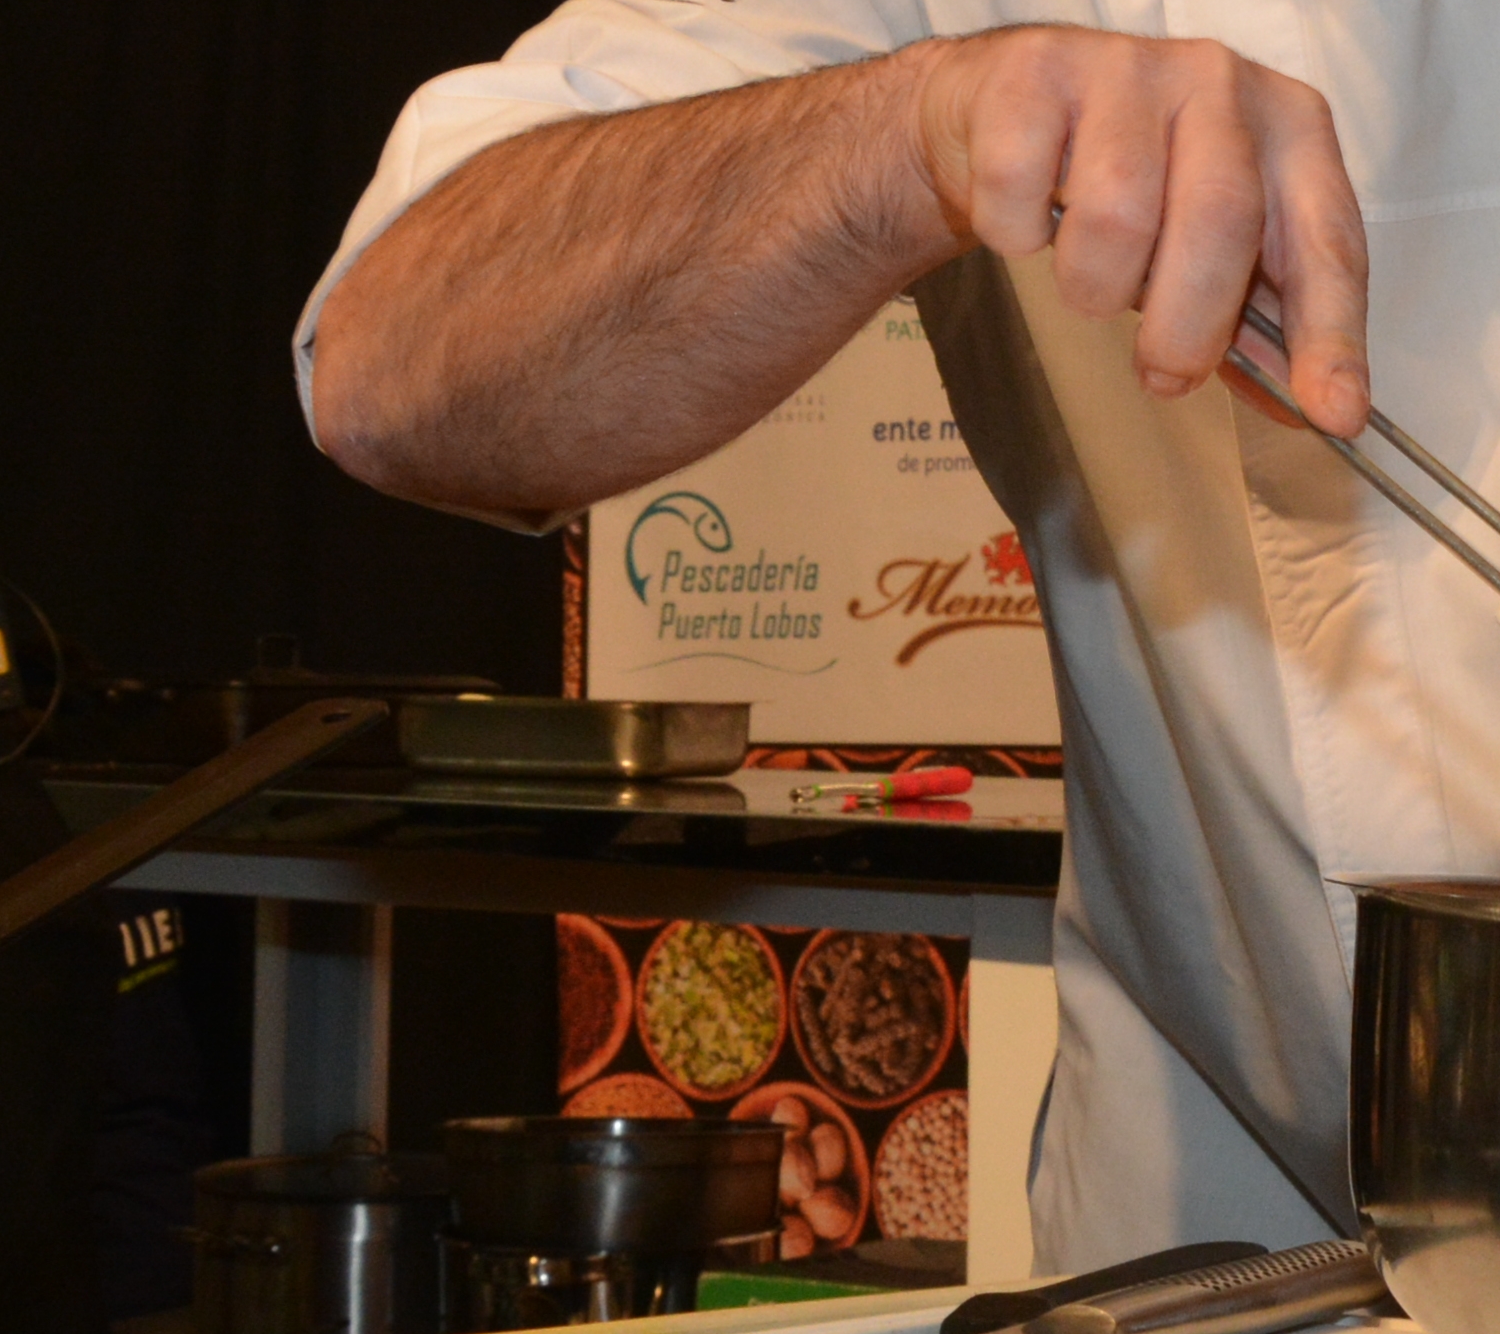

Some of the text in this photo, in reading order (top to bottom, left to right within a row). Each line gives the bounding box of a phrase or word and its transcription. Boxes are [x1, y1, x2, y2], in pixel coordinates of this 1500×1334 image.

[872, 417, 932, 443] ente
[897, 453, 977, 476] de prom
[660, 547, 820, 593] Pescadería
[657, 601, 823, 640] Puerto Lobos
